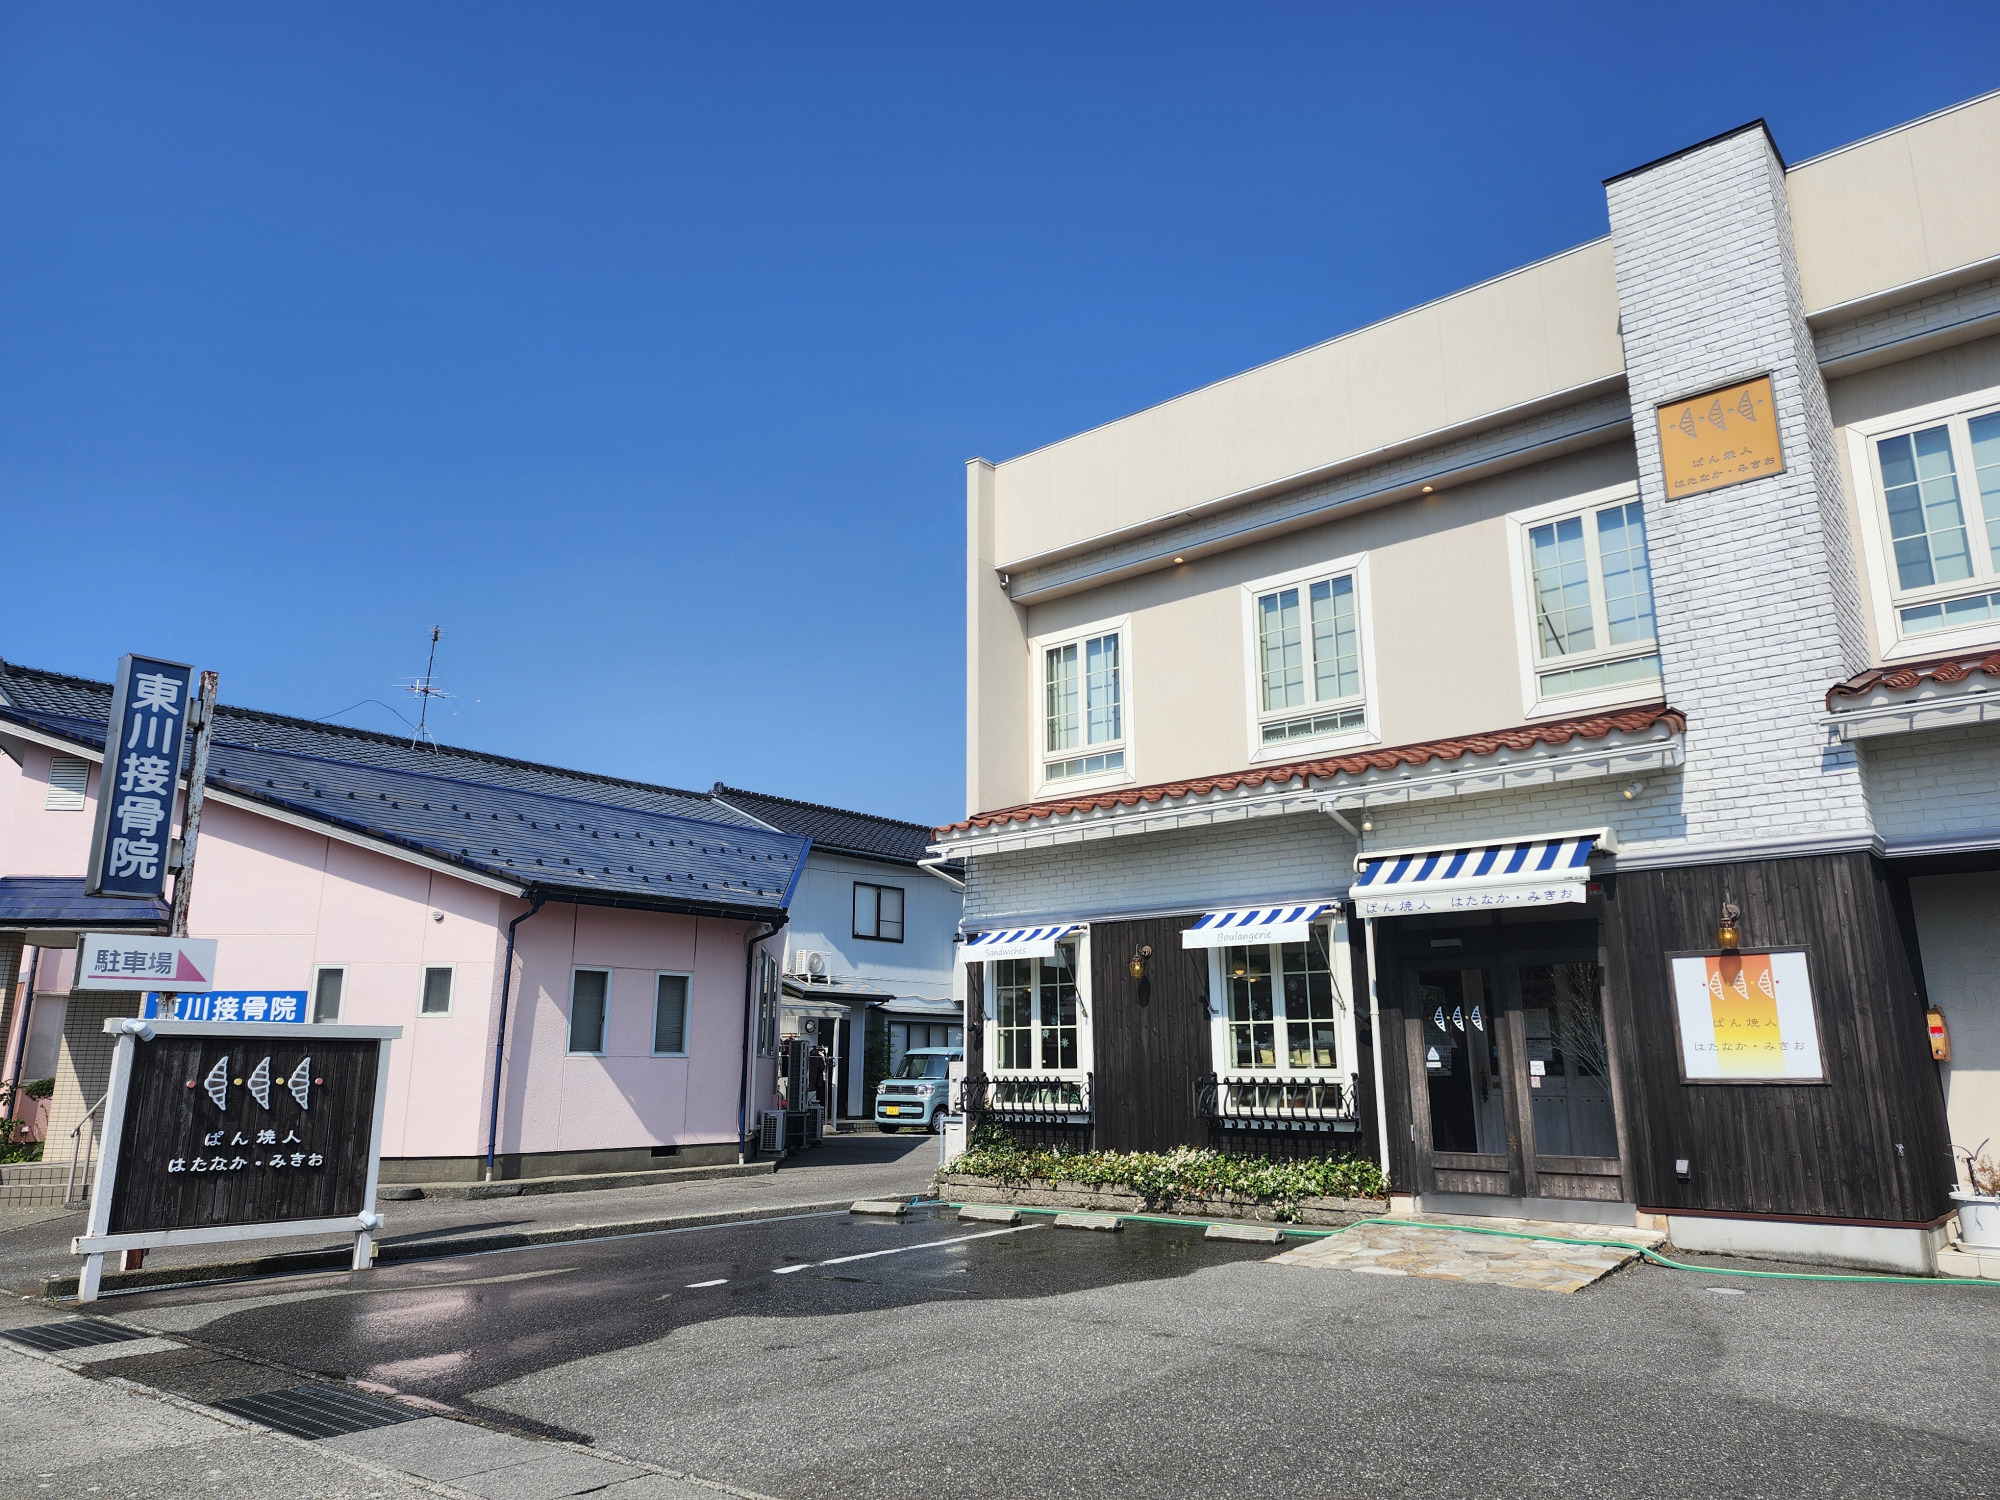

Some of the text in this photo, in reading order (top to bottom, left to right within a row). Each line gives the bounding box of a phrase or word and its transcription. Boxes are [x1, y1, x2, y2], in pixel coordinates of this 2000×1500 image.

[108, 672, 183, 880] 東川接骨院
[1367, 889, 1572, 914] ぱん焼人 はたなか・みきお
[1216, 929, 1272, 943] Boulangerie
[985, 946, 1027, 958] Sandwiches
[94, 949, 173, 975] 駐車場
[1713, 1018, 1777, 1027] ぱん焼人
[1694, 1042, 1804, 1051] はたなか・みきお
[204, 1129, 301, 1147] ぱん焼人
[168, 1152, 324, 1174] はたなか・みきお
